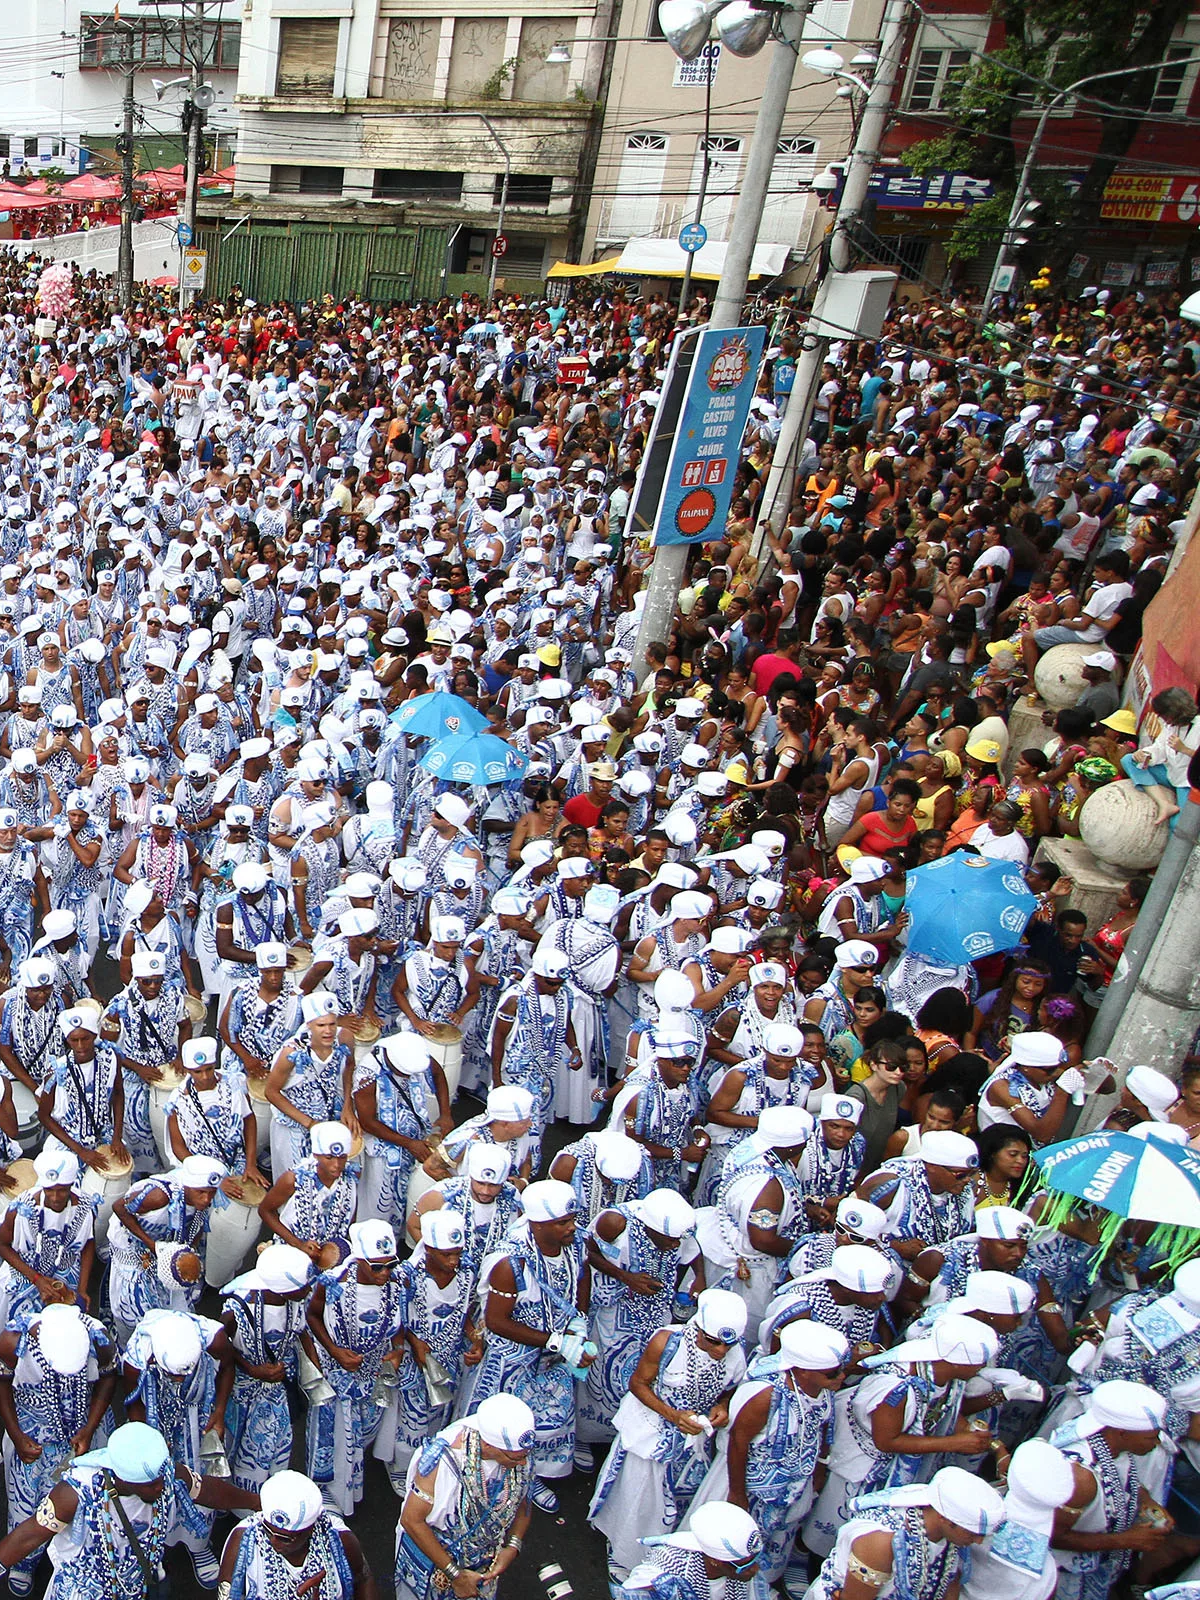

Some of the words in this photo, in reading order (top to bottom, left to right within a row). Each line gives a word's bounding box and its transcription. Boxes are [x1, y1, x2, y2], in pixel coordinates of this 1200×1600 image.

[922, 201, 965, 211] DAS
[708, 395, 736, 410] PRAÇA
[702, 409, 736, 424] CASTRO
[702, 424, 728, 439] ALVES
[696, 441, 725, 457] SAÚDE
[680, 506, 711, 519] ITAIPAVA
[1043, 1136, 1111, 1168] GANDHI
[1082, 1150, 1135, 1203] GANDHI
